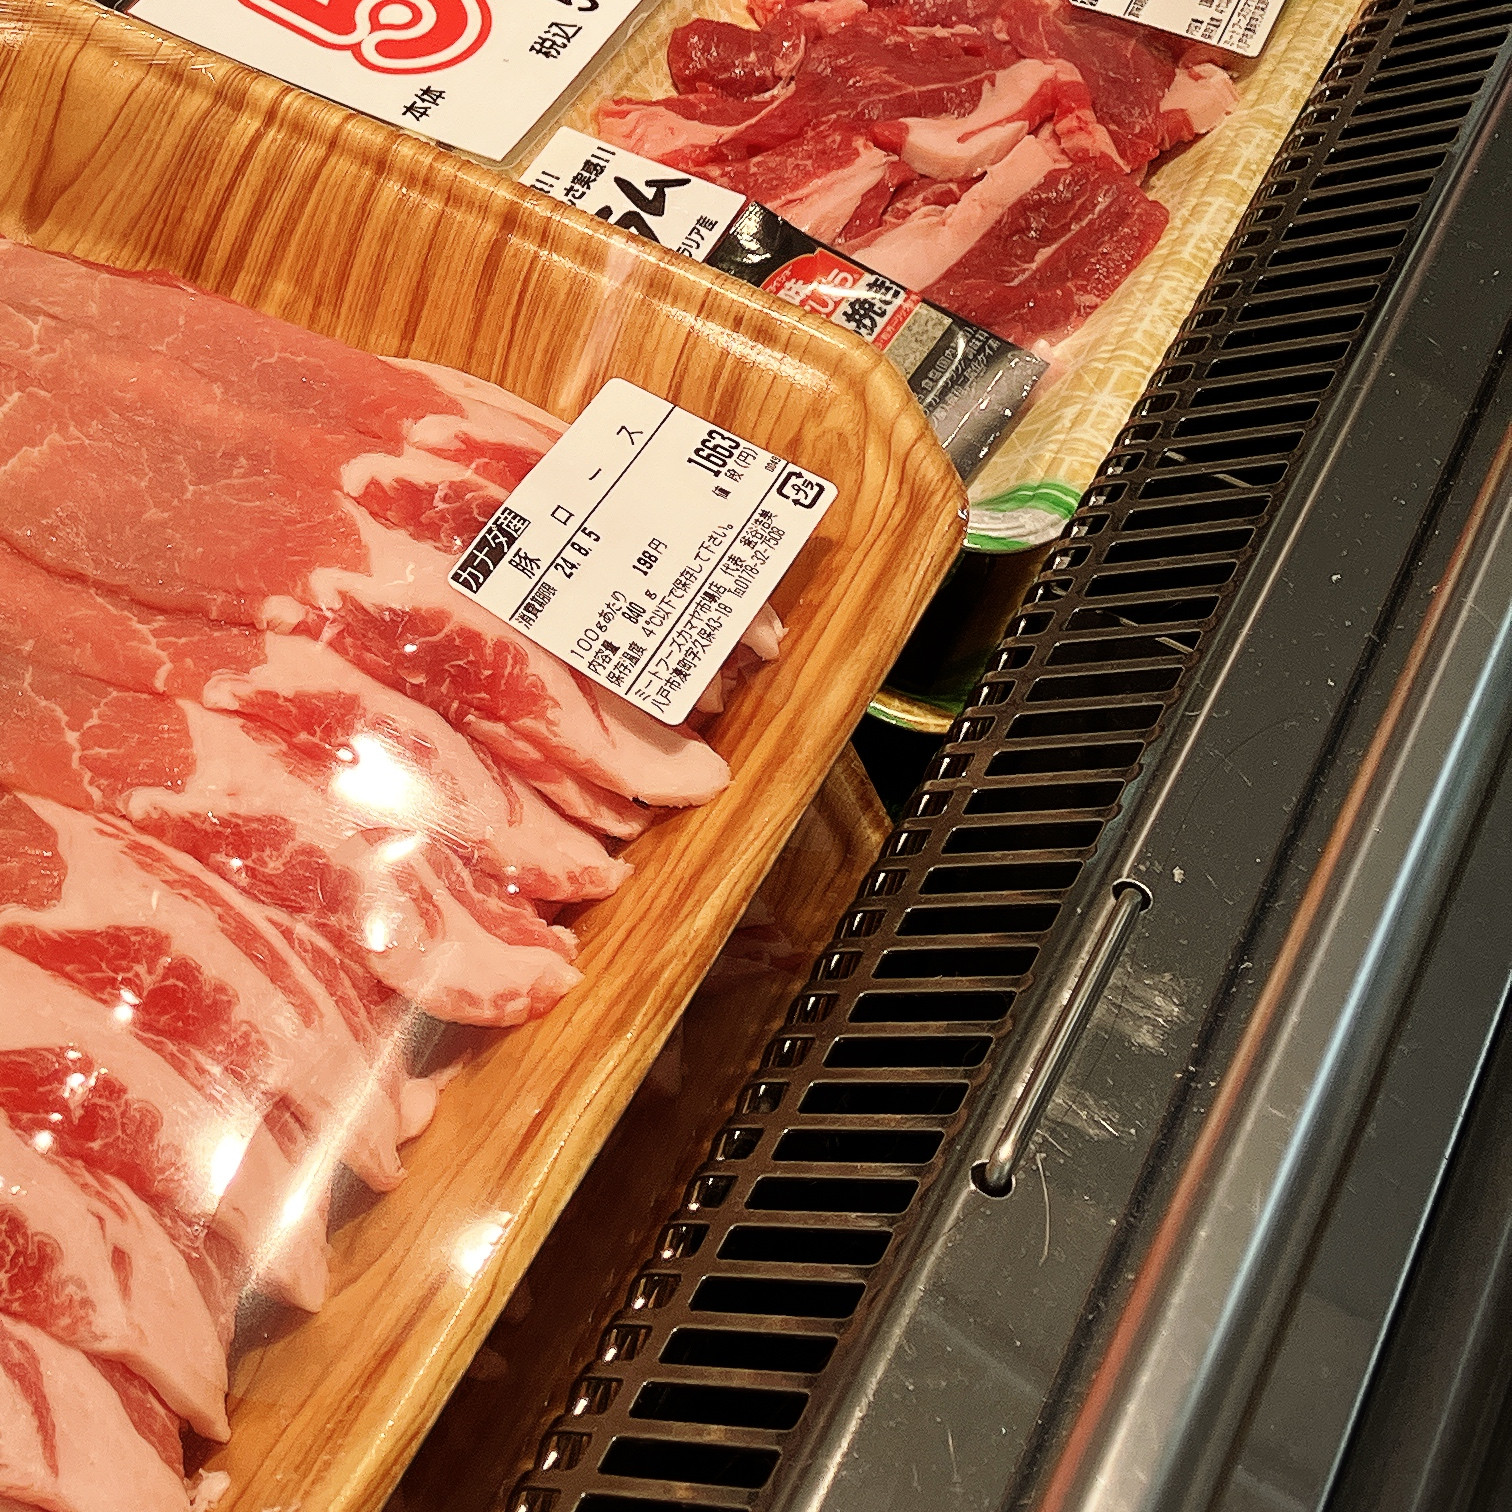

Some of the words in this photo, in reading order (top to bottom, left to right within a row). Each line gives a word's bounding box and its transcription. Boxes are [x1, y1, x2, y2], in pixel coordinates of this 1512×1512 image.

[526, 19, 584, 60] 税込
[401, 85, 447, 124] 本体
[686, 428, 740, 477] 1663
[507, 425, 643, 579] 豚ロース
[449, 505, 531, 594] カナダ産
[719, 552, 746, 578] 代表
[514, 581, 557, 630] 消費期限
[569, 590, 627, 659] 100gあたり
[631, 537, 668, 576] 198円
[586, 639, 620, 676] 内容量
[620, 600, 647, 624] 840
[605, 640, 647, 687] 保存温度
